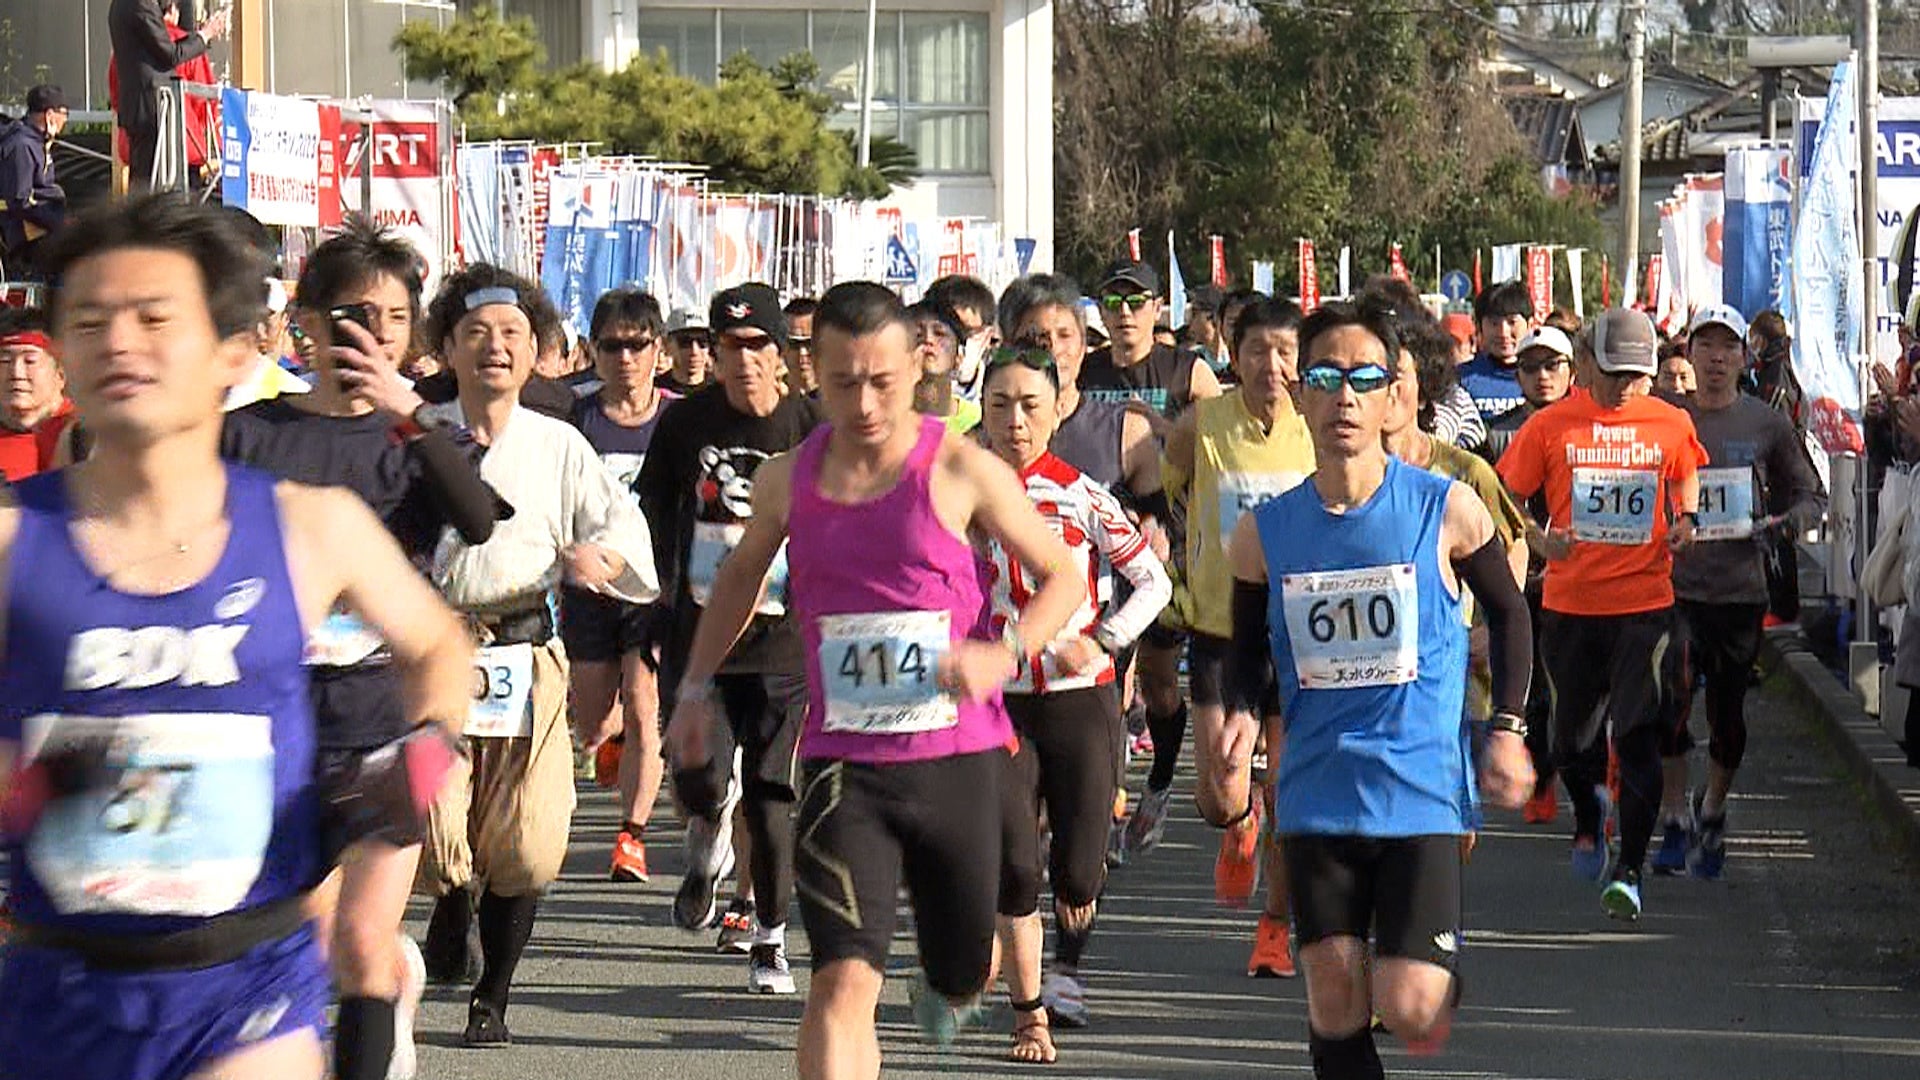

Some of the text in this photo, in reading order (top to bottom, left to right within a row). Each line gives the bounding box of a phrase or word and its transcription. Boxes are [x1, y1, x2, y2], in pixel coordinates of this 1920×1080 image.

[1593, 422, 1637, 444] Power
[1587, 485, 1644, 516] 516
[1308, 594, 1395, 643] 610
[839, 640, 928, 688] 414
